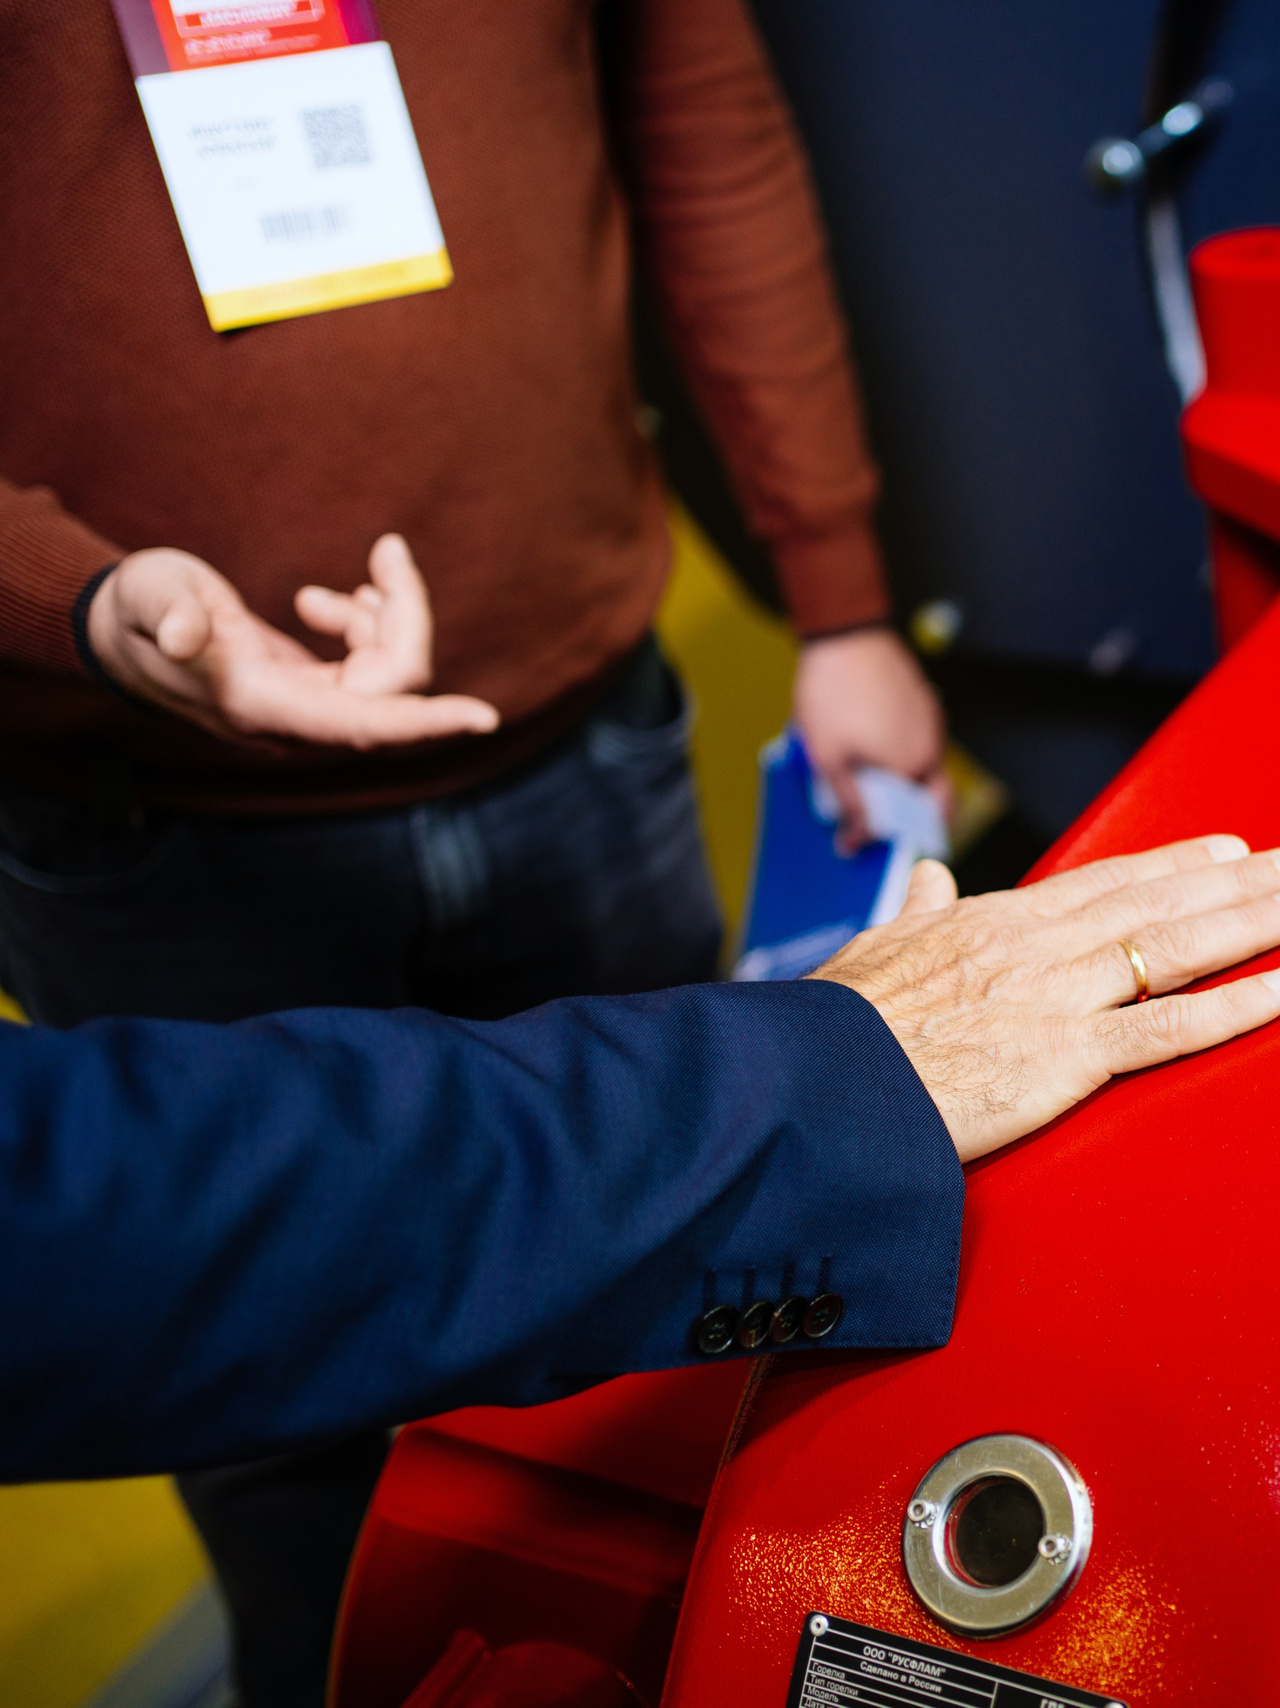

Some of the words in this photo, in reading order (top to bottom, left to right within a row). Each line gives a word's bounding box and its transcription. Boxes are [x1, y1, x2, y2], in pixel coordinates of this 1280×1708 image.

[812, 1662, 846, 1679] Горелка
[863, 1646, 886, 1660] ООО
[888, 1652, 946, 1677] "РУСФЛАМ"
[810, 1674, 826, 1686] Тип
[826, 1681, 859, 1697] горелки
[860, 1661, 899, 1680] Сделано
[908, 1675, 942, 1693] России
[807, 1686, 840, 1703] Модель
